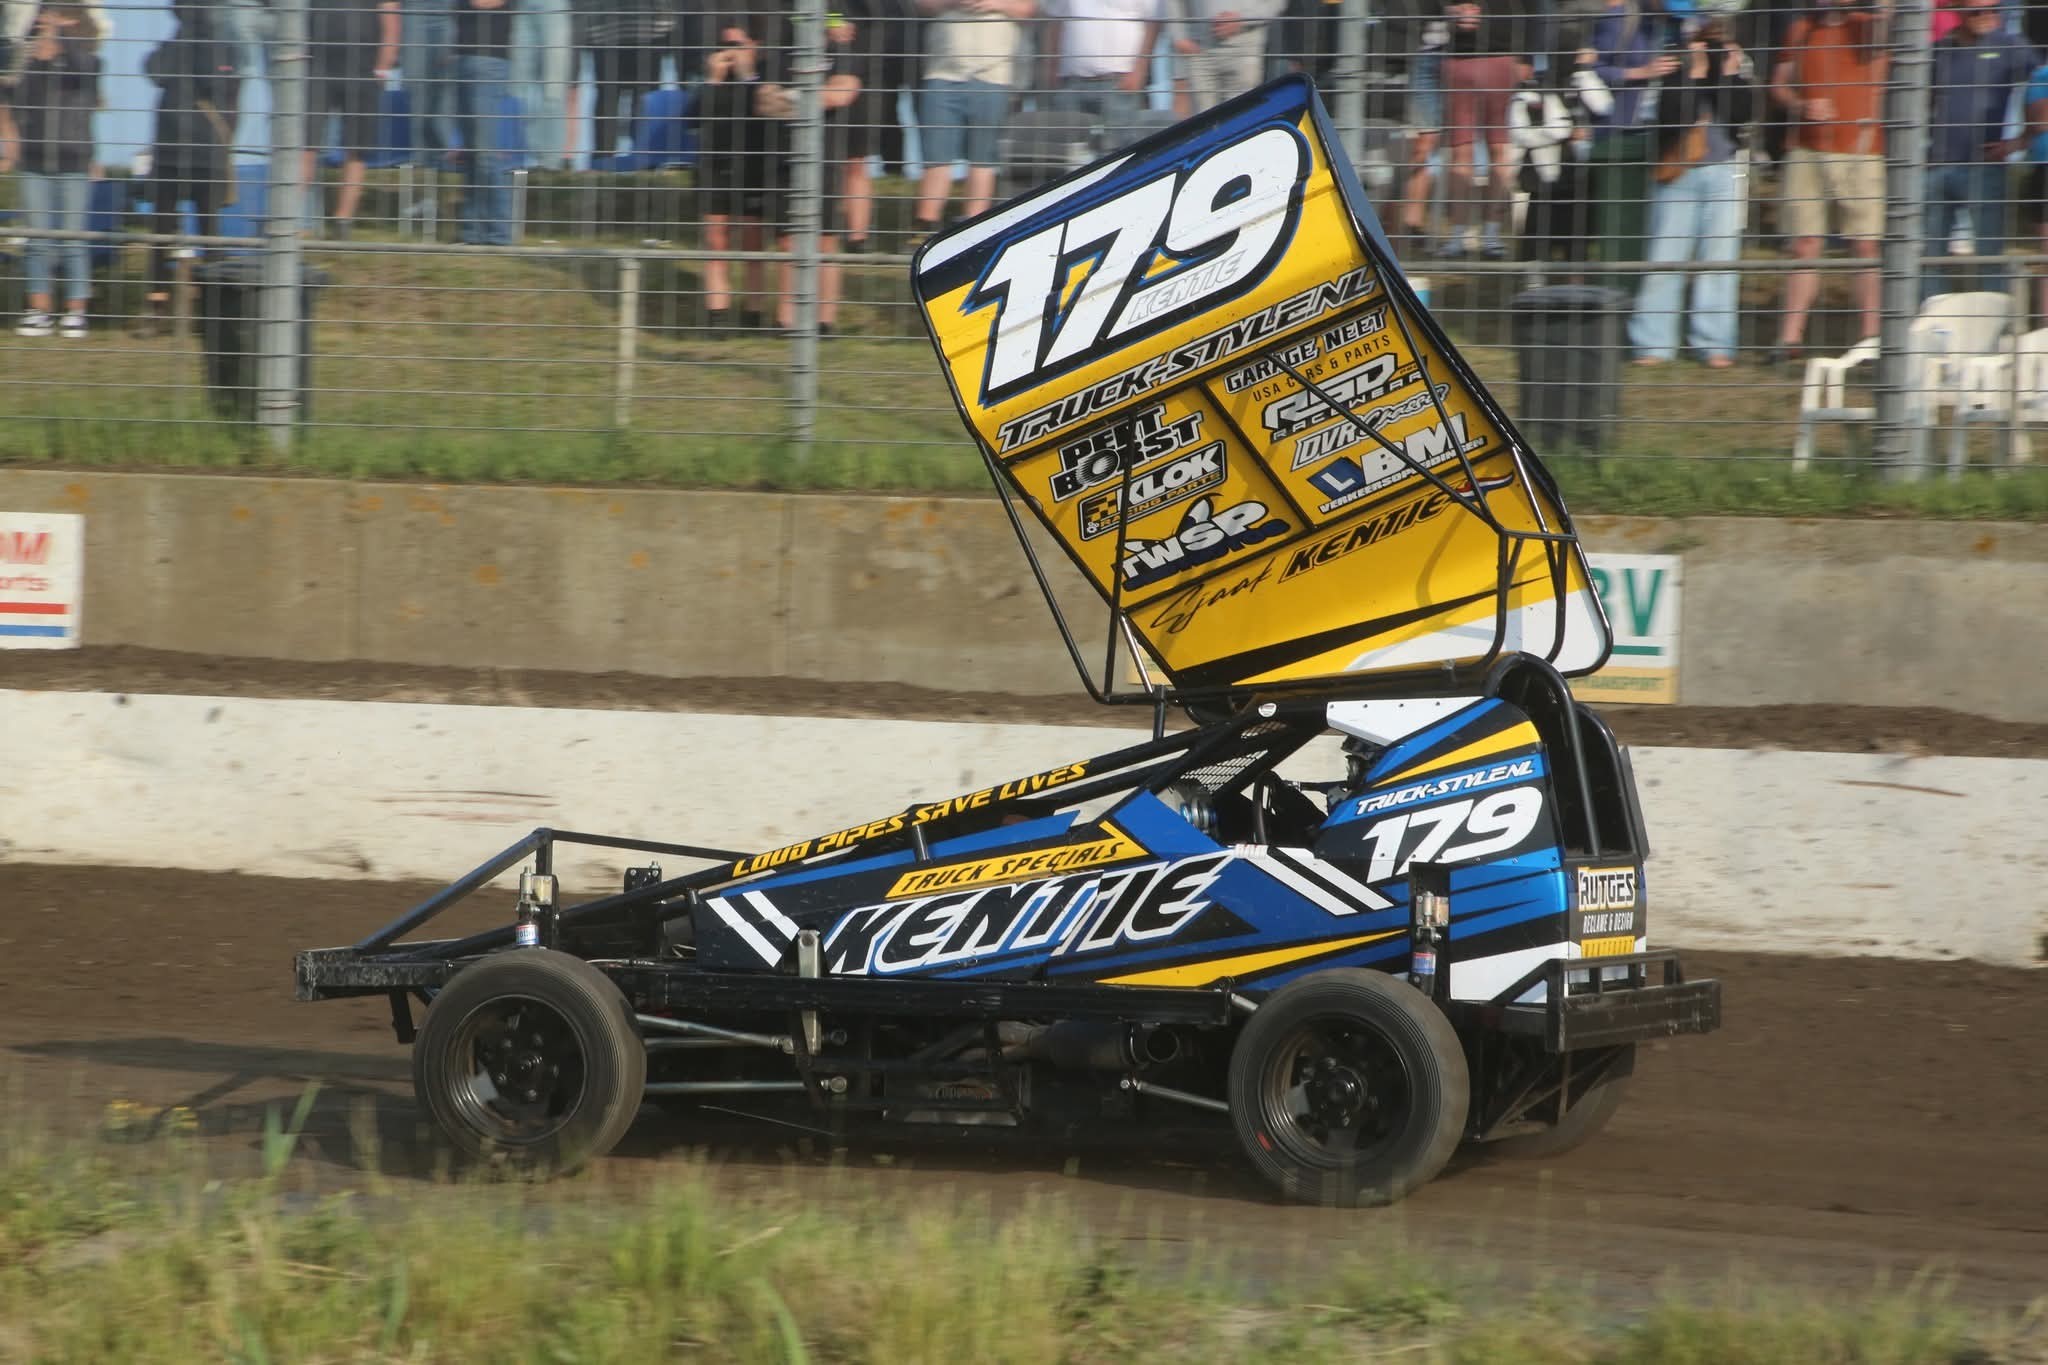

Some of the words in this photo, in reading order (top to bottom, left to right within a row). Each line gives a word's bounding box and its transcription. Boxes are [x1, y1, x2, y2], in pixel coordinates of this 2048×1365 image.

[977, 127, 1302, 393] 179
[1127, 249, 1248, 324] KENTIE
[1224, 338, 1320, 394] GARAGE
[1323, 306, 1387, 353] NEET
[1252, 382, 1281, 402] USA
[1287, 364, 1324, 388] CRS
[1330, 357, 1339, 369] &
[1346, 335, 1391, 362] PARTS
[1116, 446, 1220, 511] KLOK
[1292, 420, 1359, 469] DVR
[1319, 436, 1487, 513] VERKEERSOPEIDINEN
[1167, 472, 1221, 499] PARTS
[1120, 502, 1267, 579] TWSP
[1279, 492, 1451, 584] KENTIE
[733, 840, 815, 877] LOUD
[819, 814, 907, 852] PIPES
[911, 787, 993, 826] SAVE
[999, 760, 1090, 801] LIVES
[1362, 786, 1543, 883] 179
[901, 862, 995, 892] TRUCK
[997, 841, 1122, 880] SPECIALS
[1579, 871, 1634, 906] RUTGES
[825, 850, 1232, 975] KENTIE
